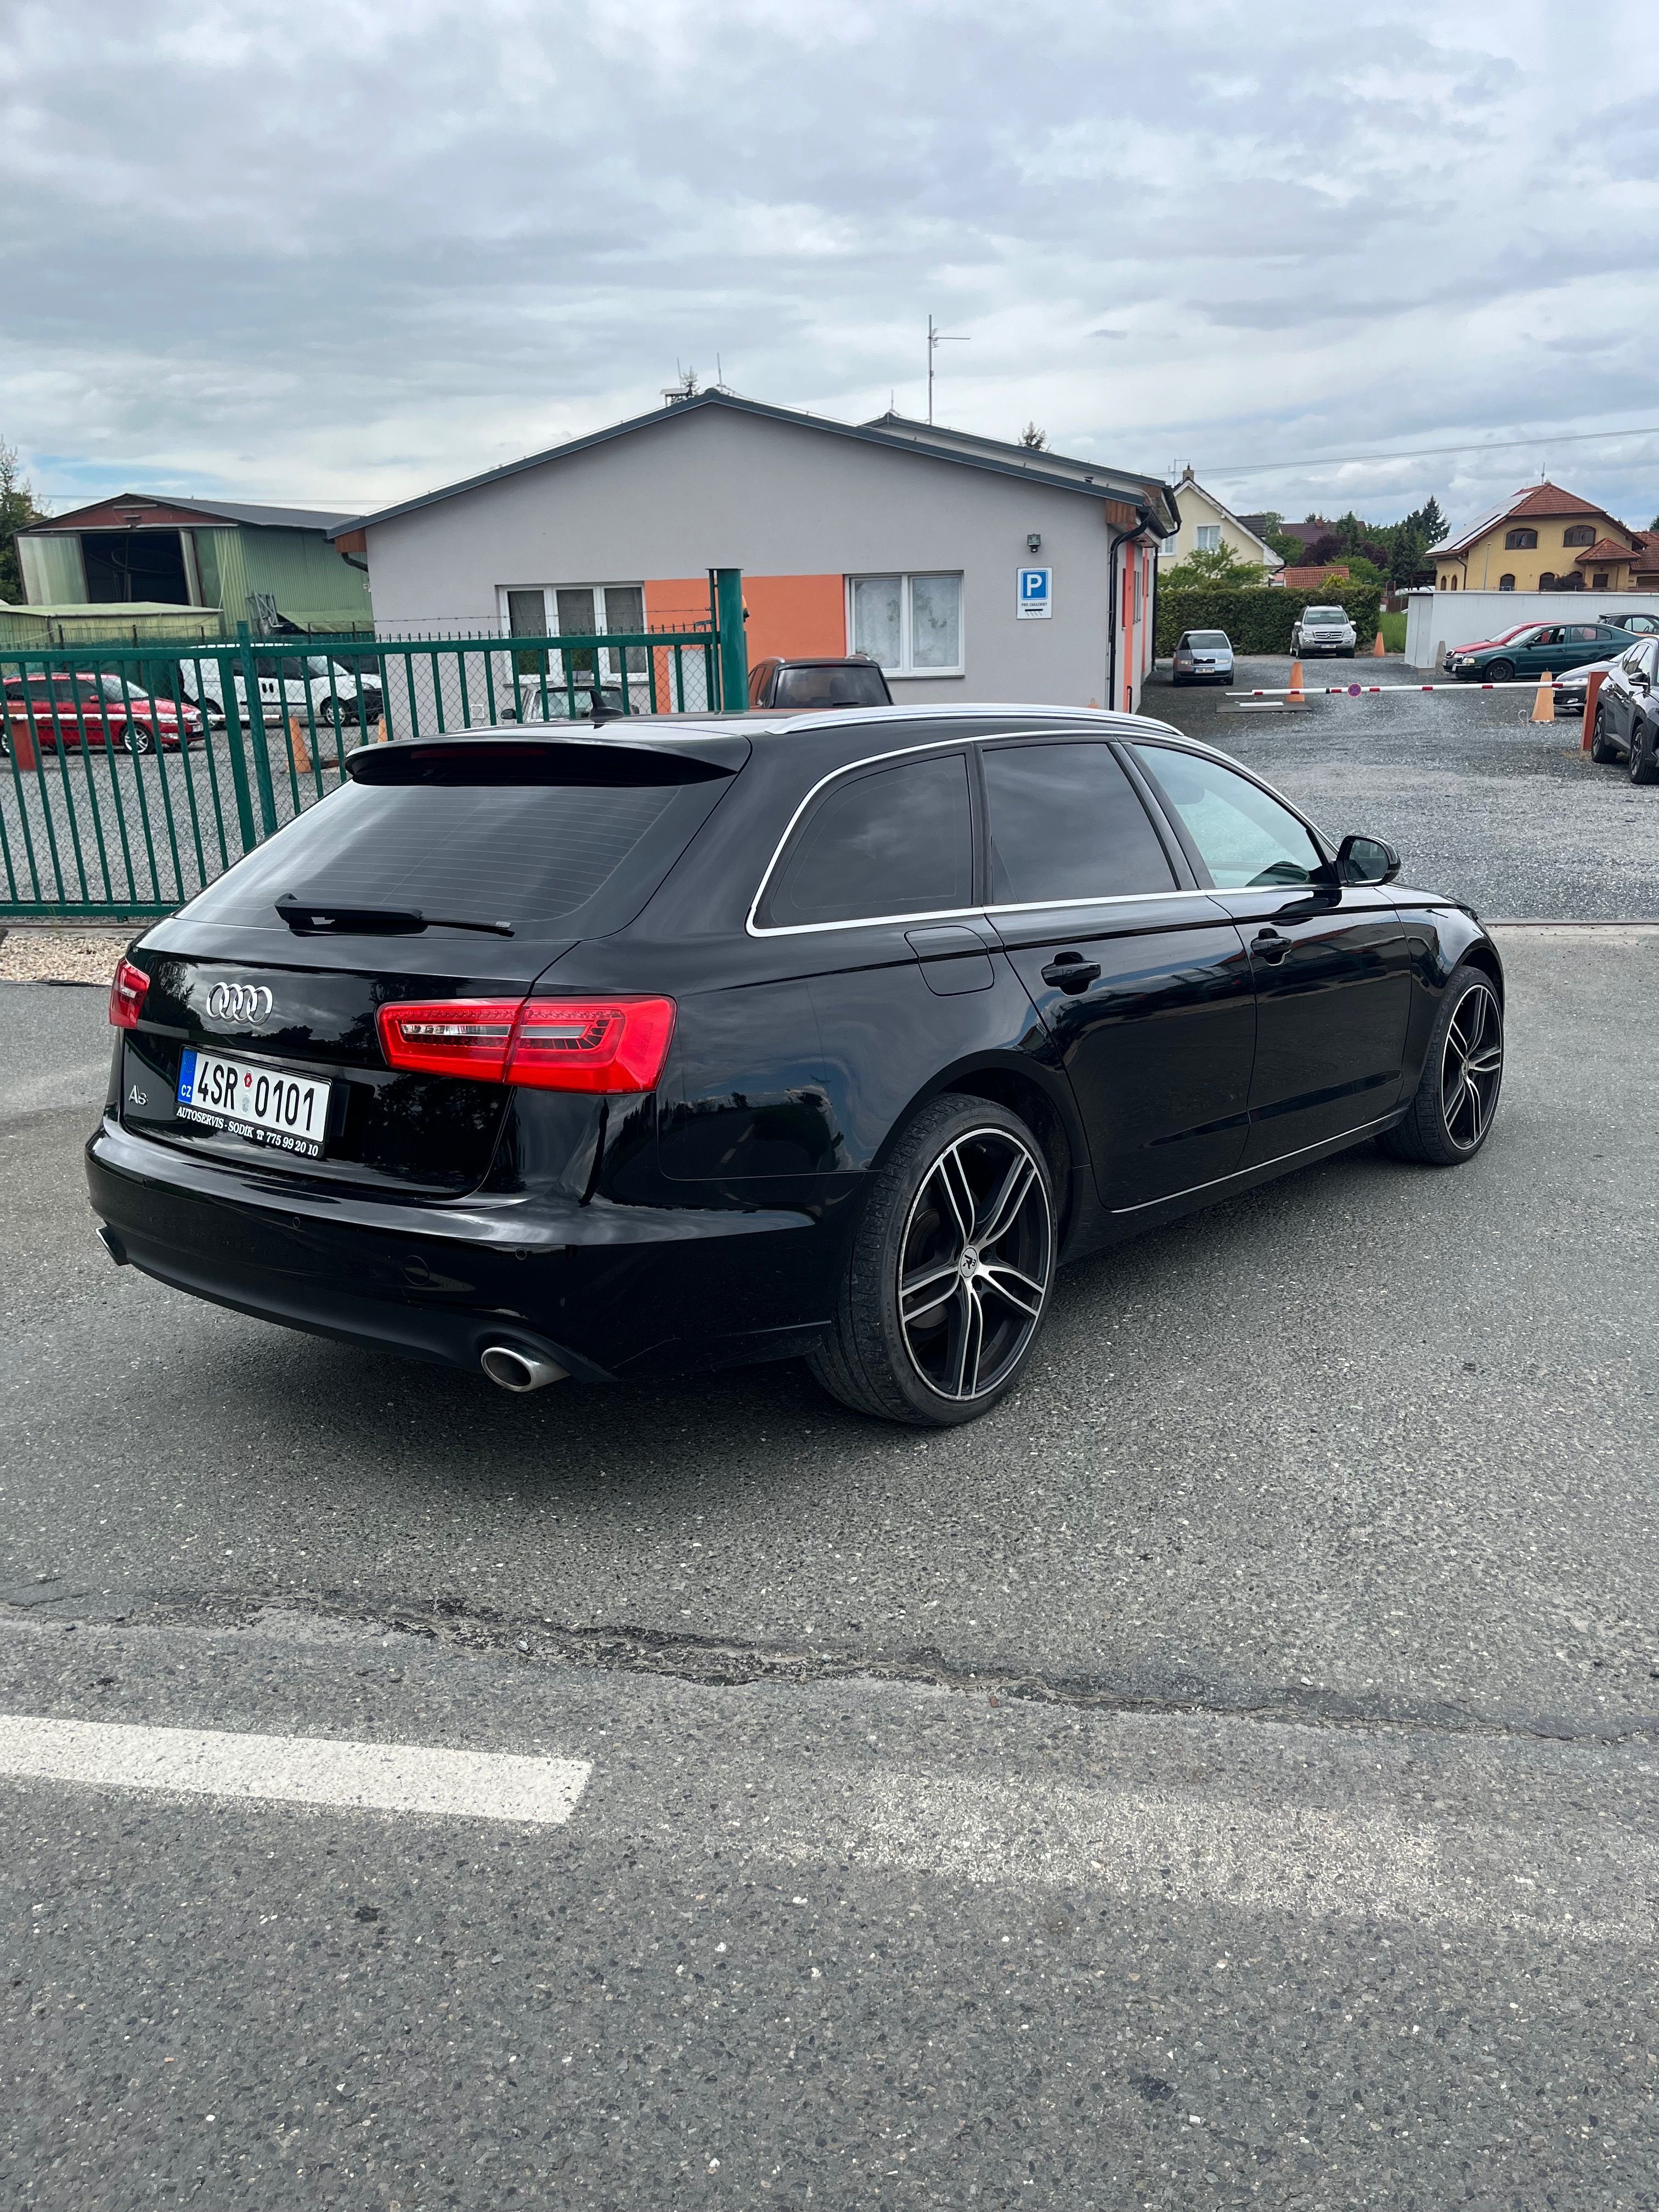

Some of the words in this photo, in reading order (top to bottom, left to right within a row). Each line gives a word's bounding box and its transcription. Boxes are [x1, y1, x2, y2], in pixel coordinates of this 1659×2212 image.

[1026, 574, 1042, 596] P
[129, 1085, 148, 1105] A6
[181, 1084, 191, 1098] CZ
[198, 1061, 238, 1110] 4SR
[255, 1075, 314, 1131] 0101
[177, 1107, 224, 1129] AUTOSERVIS
[266, 1132, 281, 1146] 775
[283, 1137, 294, 1150] 99
[295, 1140, 306, 1153] 20
[307, 1144, 319, 1157] 10
